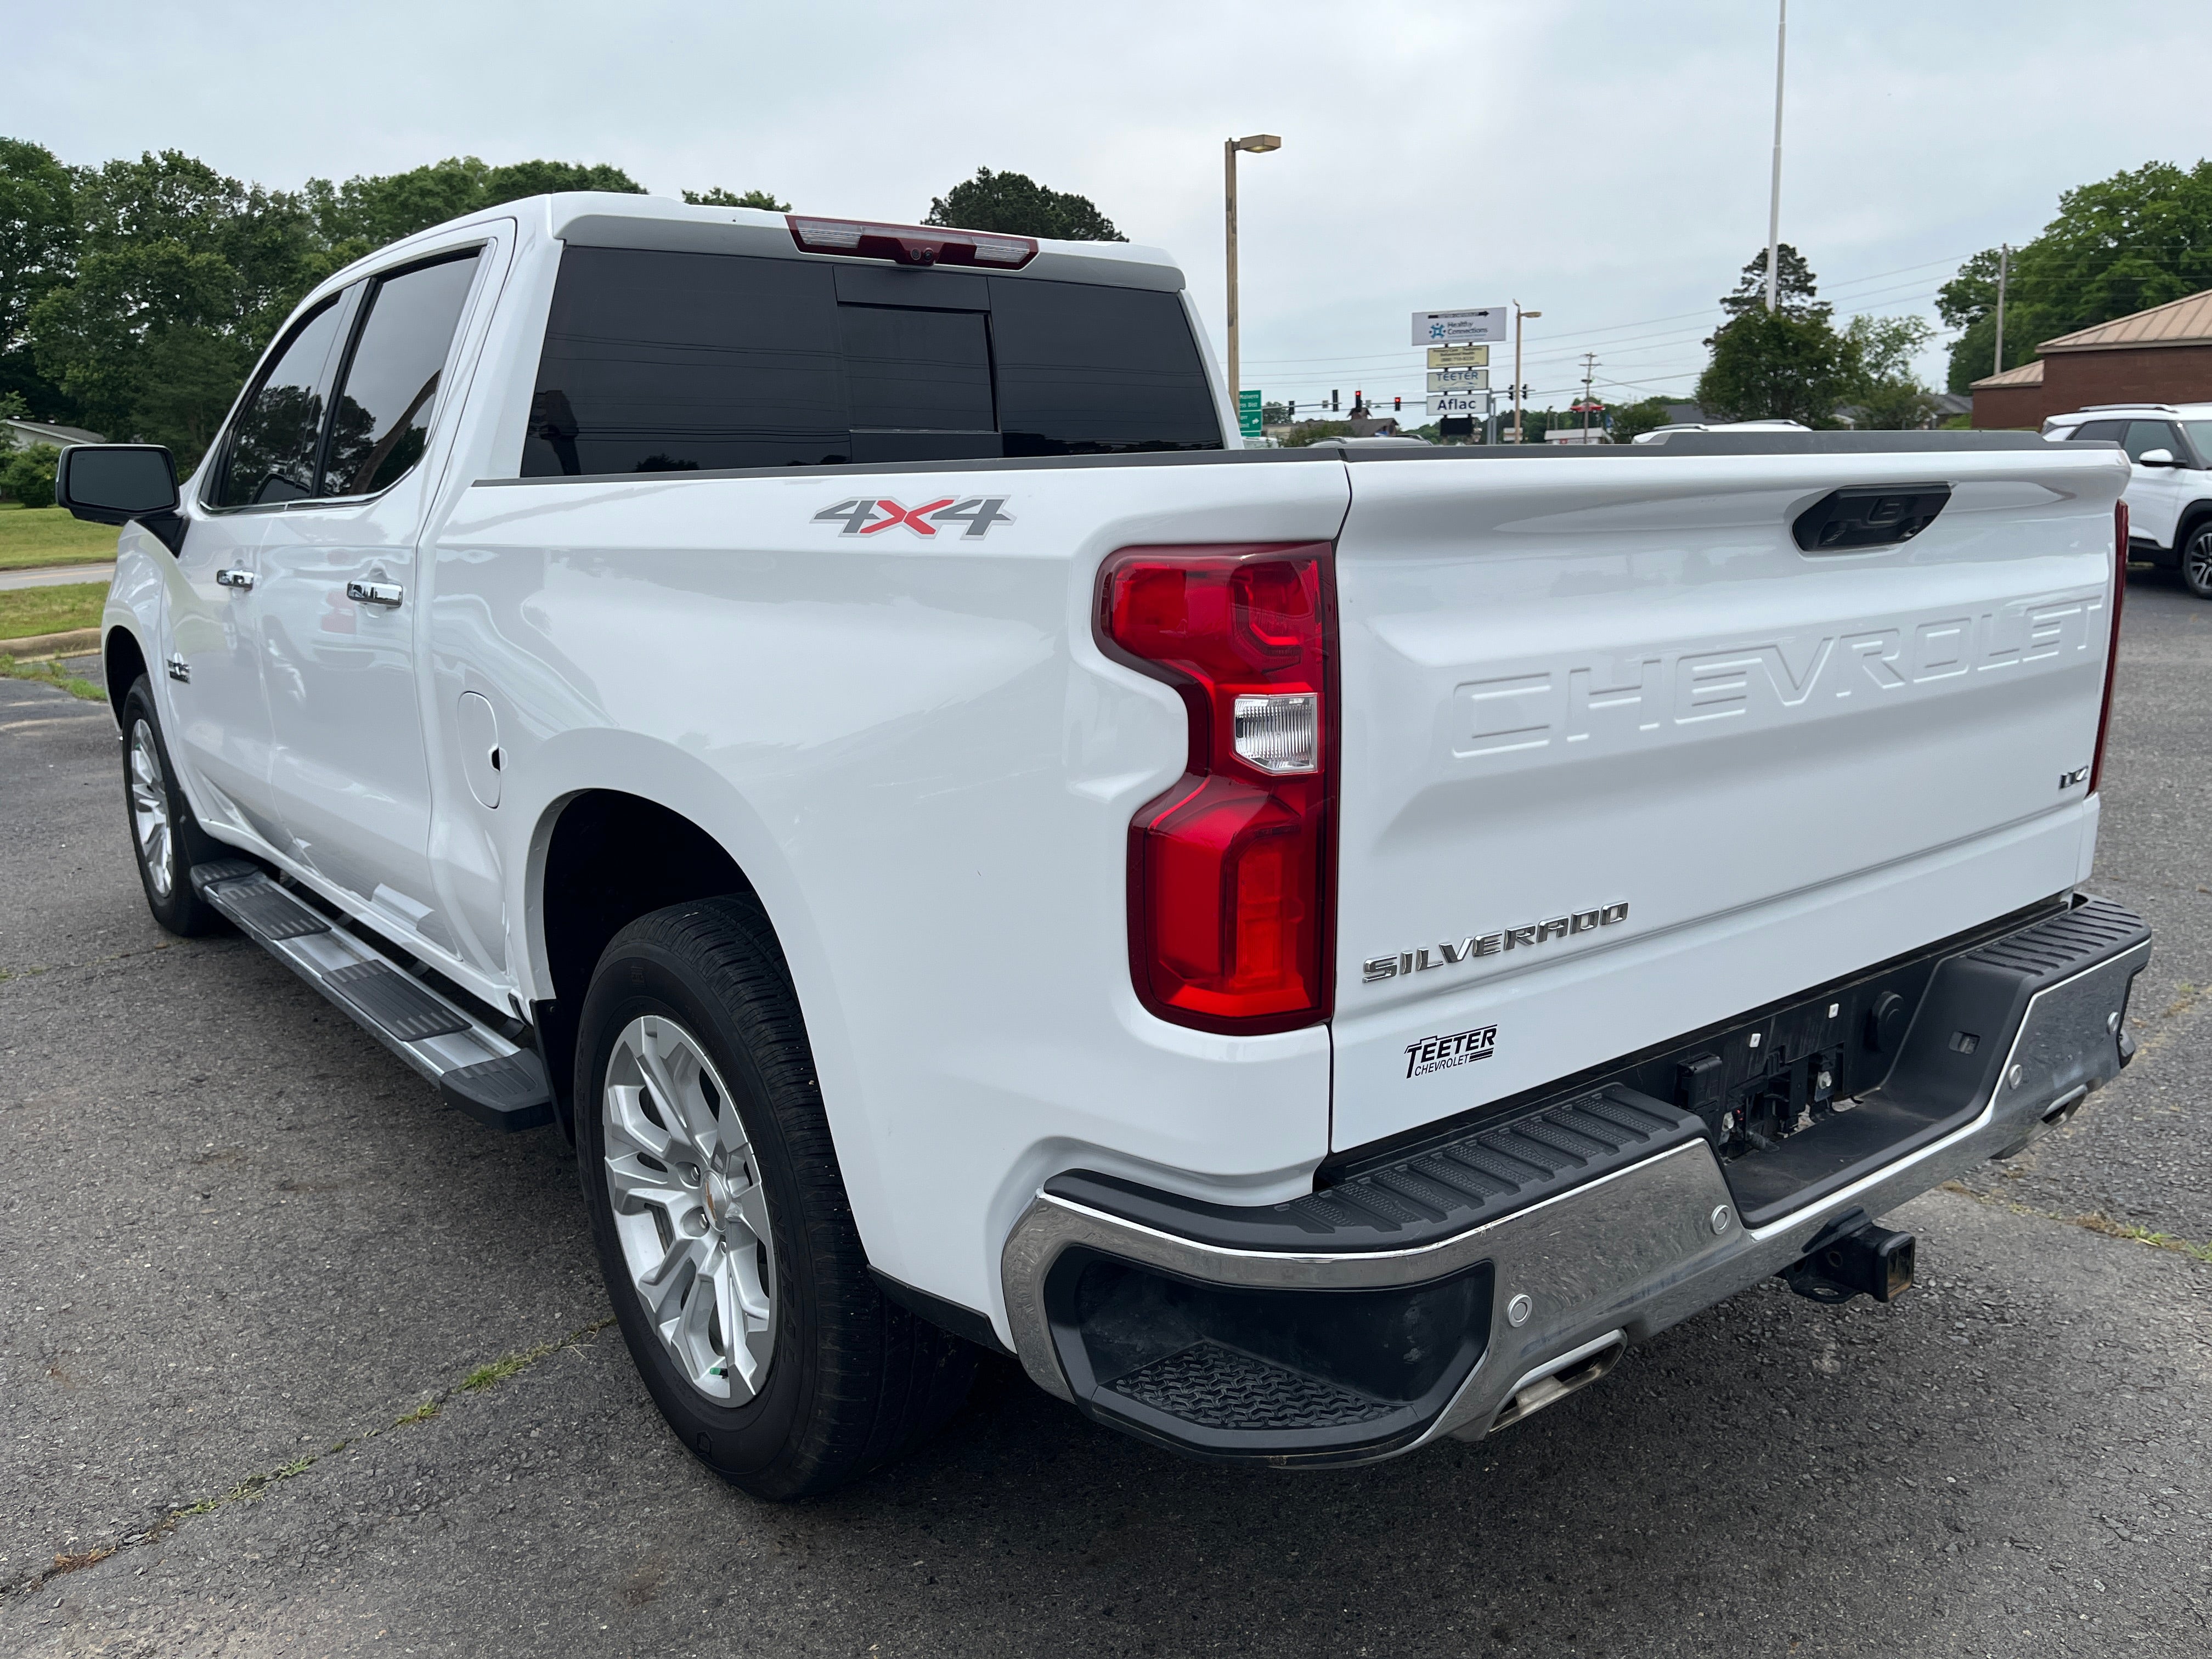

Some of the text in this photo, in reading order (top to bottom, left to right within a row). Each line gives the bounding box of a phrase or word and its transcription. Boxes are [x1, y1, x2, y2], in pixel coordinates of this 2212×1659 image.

[1436, 371, 1479, 381] TEETER
[1437, 398, 1476, 410] Aflac
[1453, 595, 2103, 759] CHEVROLET
[1362, 899, 1629, 984] SILVERADO
[1404, 1025, 1498, 1079] TEETER
[1414, 1053, 1470, 1077] CHEVROLET
